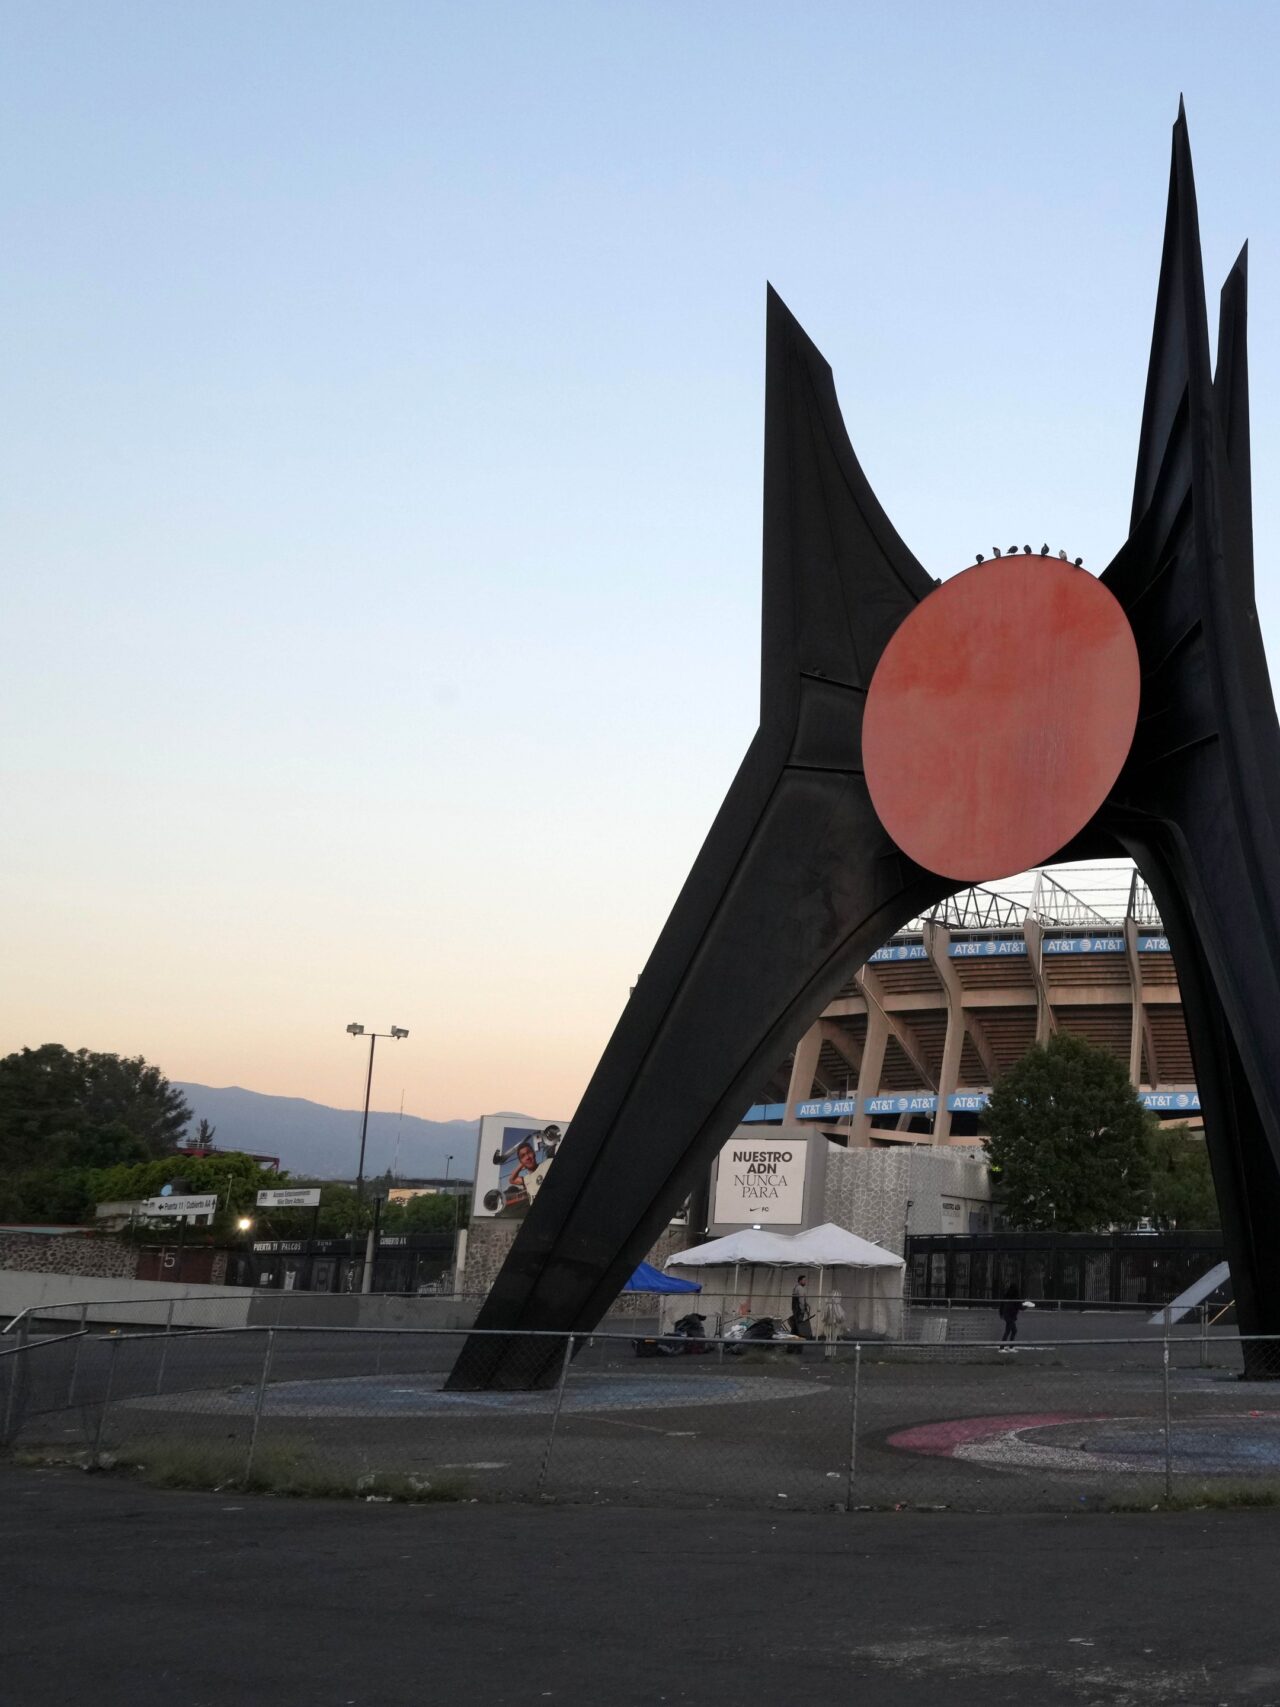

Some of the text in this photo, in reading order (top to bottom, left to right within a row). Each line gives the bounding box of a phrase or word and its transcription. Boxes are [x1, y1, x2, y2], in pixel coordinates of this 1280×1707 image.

[954, 942, 1025, 954] AT&T AT&T
[1047, 940, 1122, 951] AT&T AT&T
[1145, 939, 1168, 950] AT&
[910, 947, 928, 957] AT&
[870, 1098, 936, 1111] AT&T AT&T
[953, 1097, 981, 1108] AT&T
[1145, 1096, 1172, 1106] AT&T
[800, 1102, 855, 1115] AT&T AT&T
[733, 1151, 793, 1162] NUESTRO
[747, 1163, 777, 1174] ADN
[734, 1175, 788, 1186] NUNCA
[743, 1187, 779, 1198] PARA
